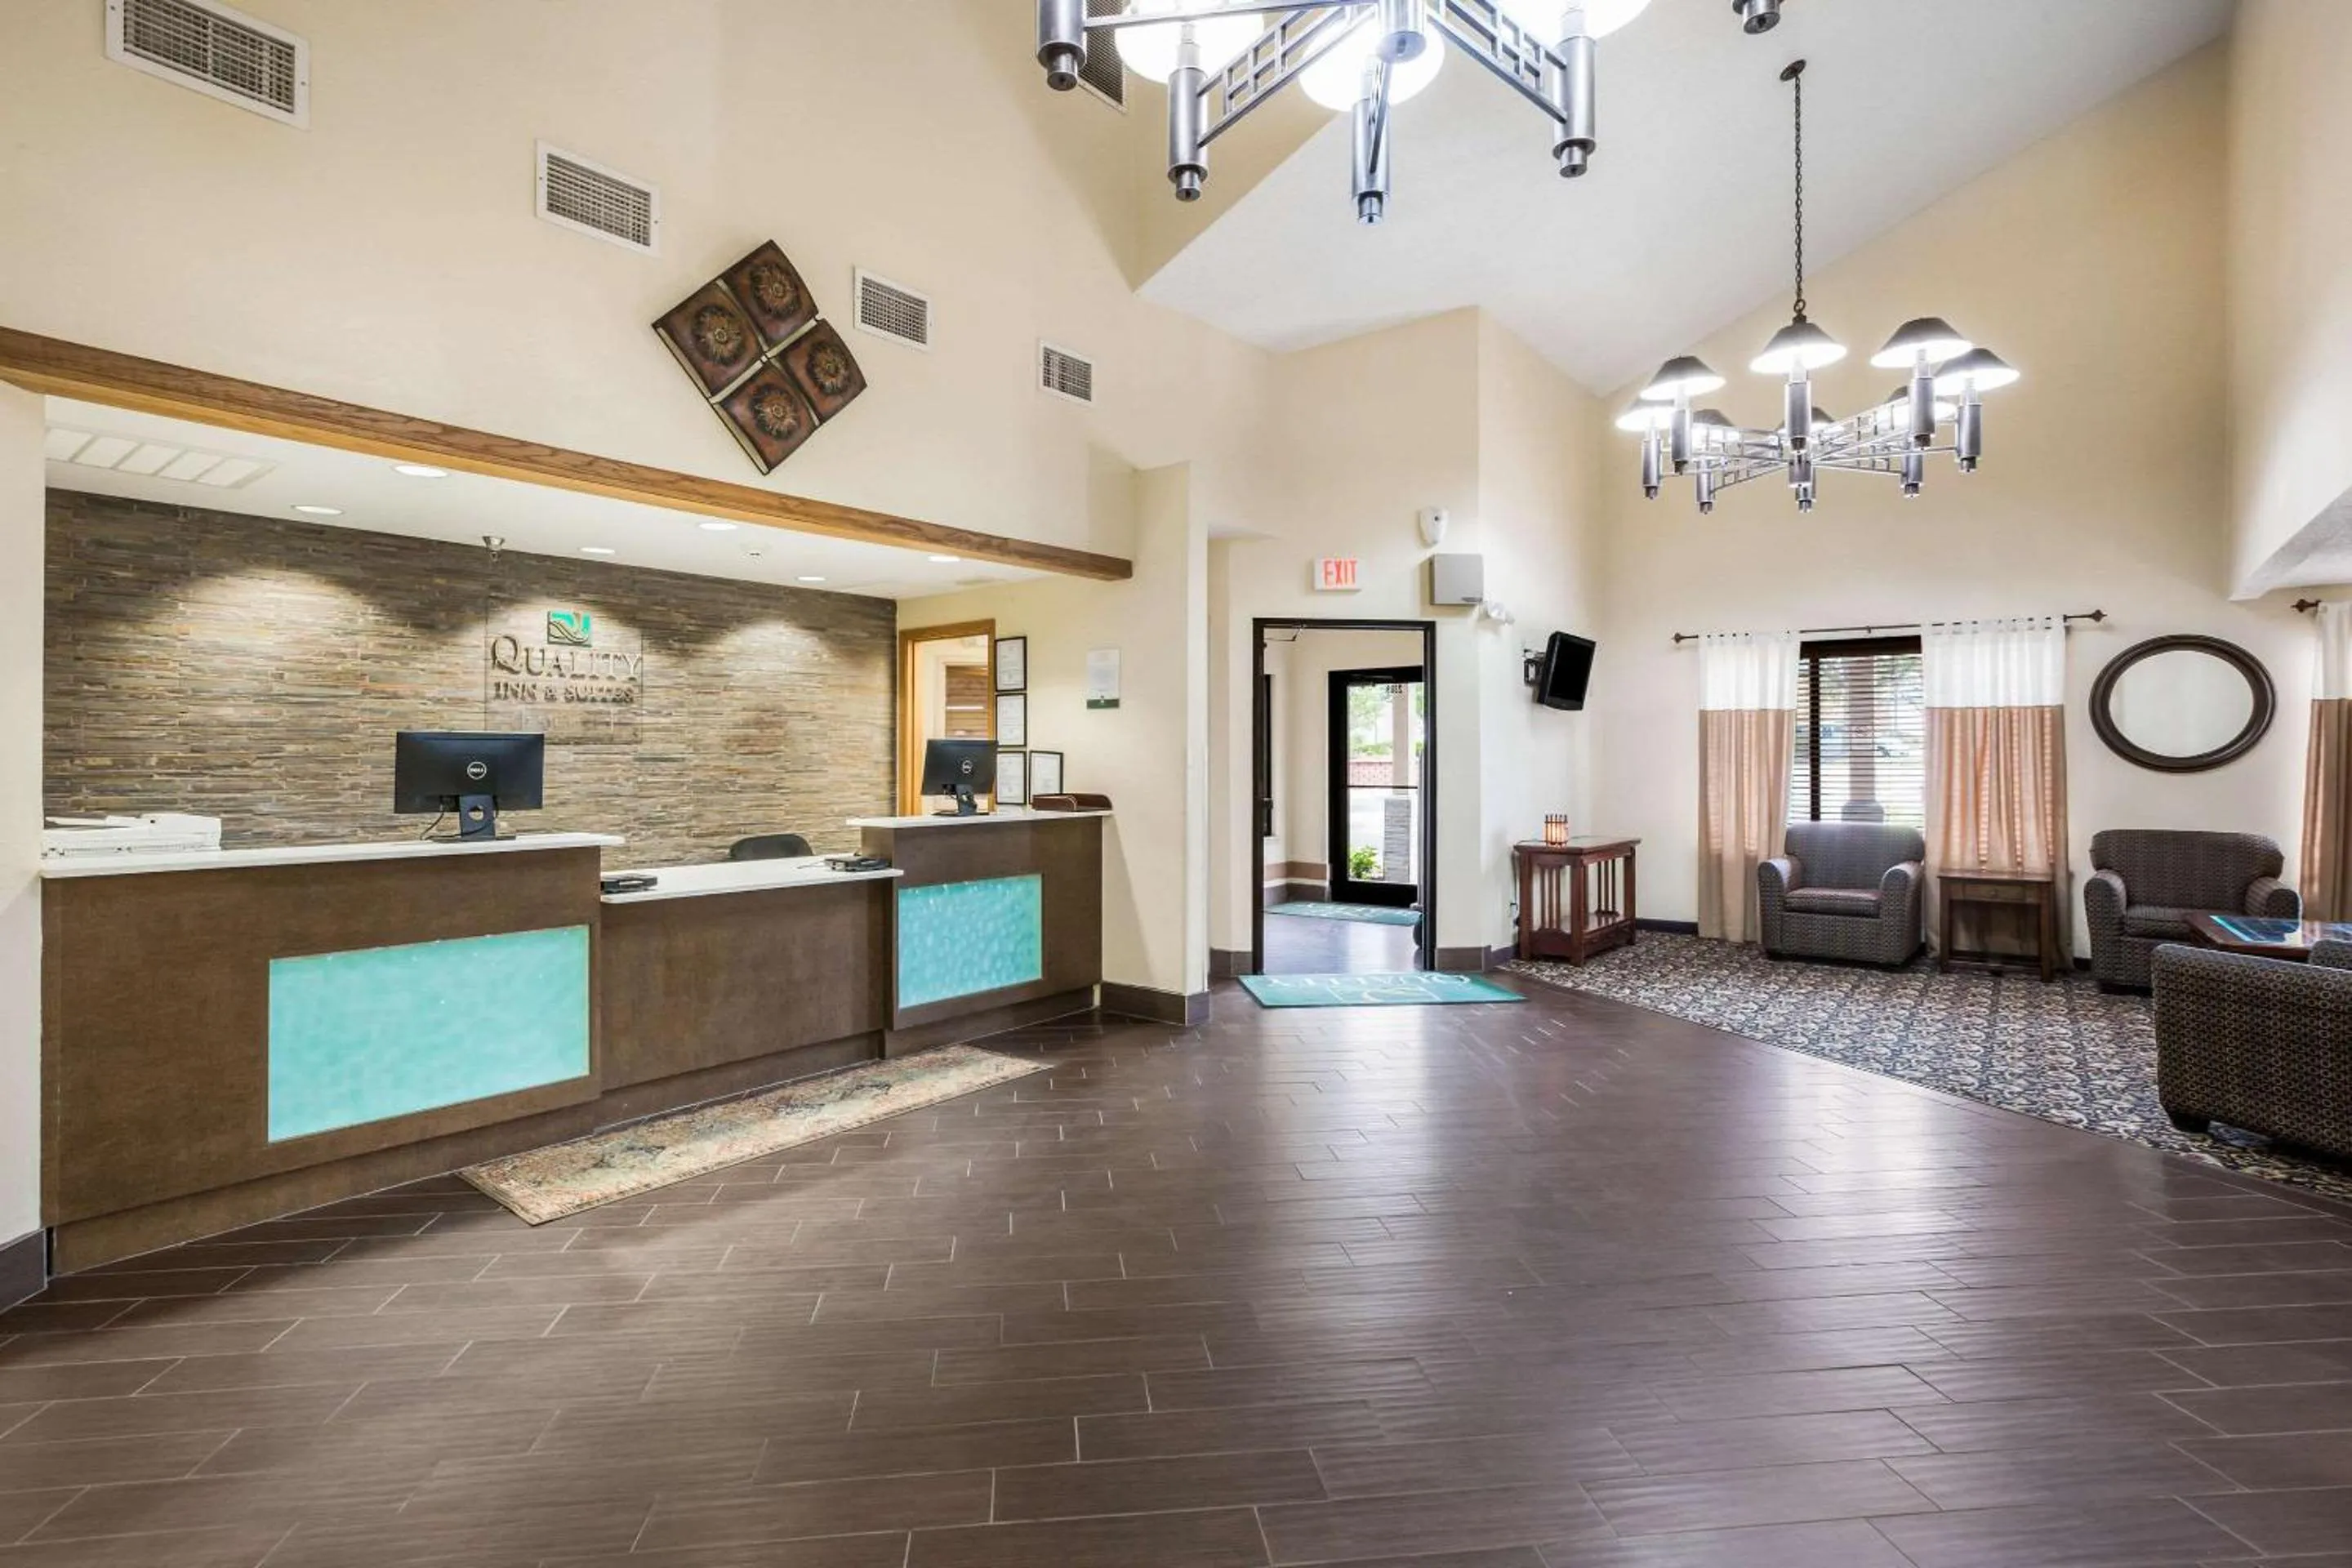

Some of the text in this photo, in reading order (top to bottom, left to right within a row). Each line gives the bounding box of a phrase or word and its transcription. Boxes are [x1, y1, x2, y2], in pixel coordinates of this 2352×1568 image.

[1323, 559, 1357, 586] EXIT
[492, 635, 641, 681] QUALITY
[493, 680, 537, 702] INN
[564, 683, 635, 703] SUITES
